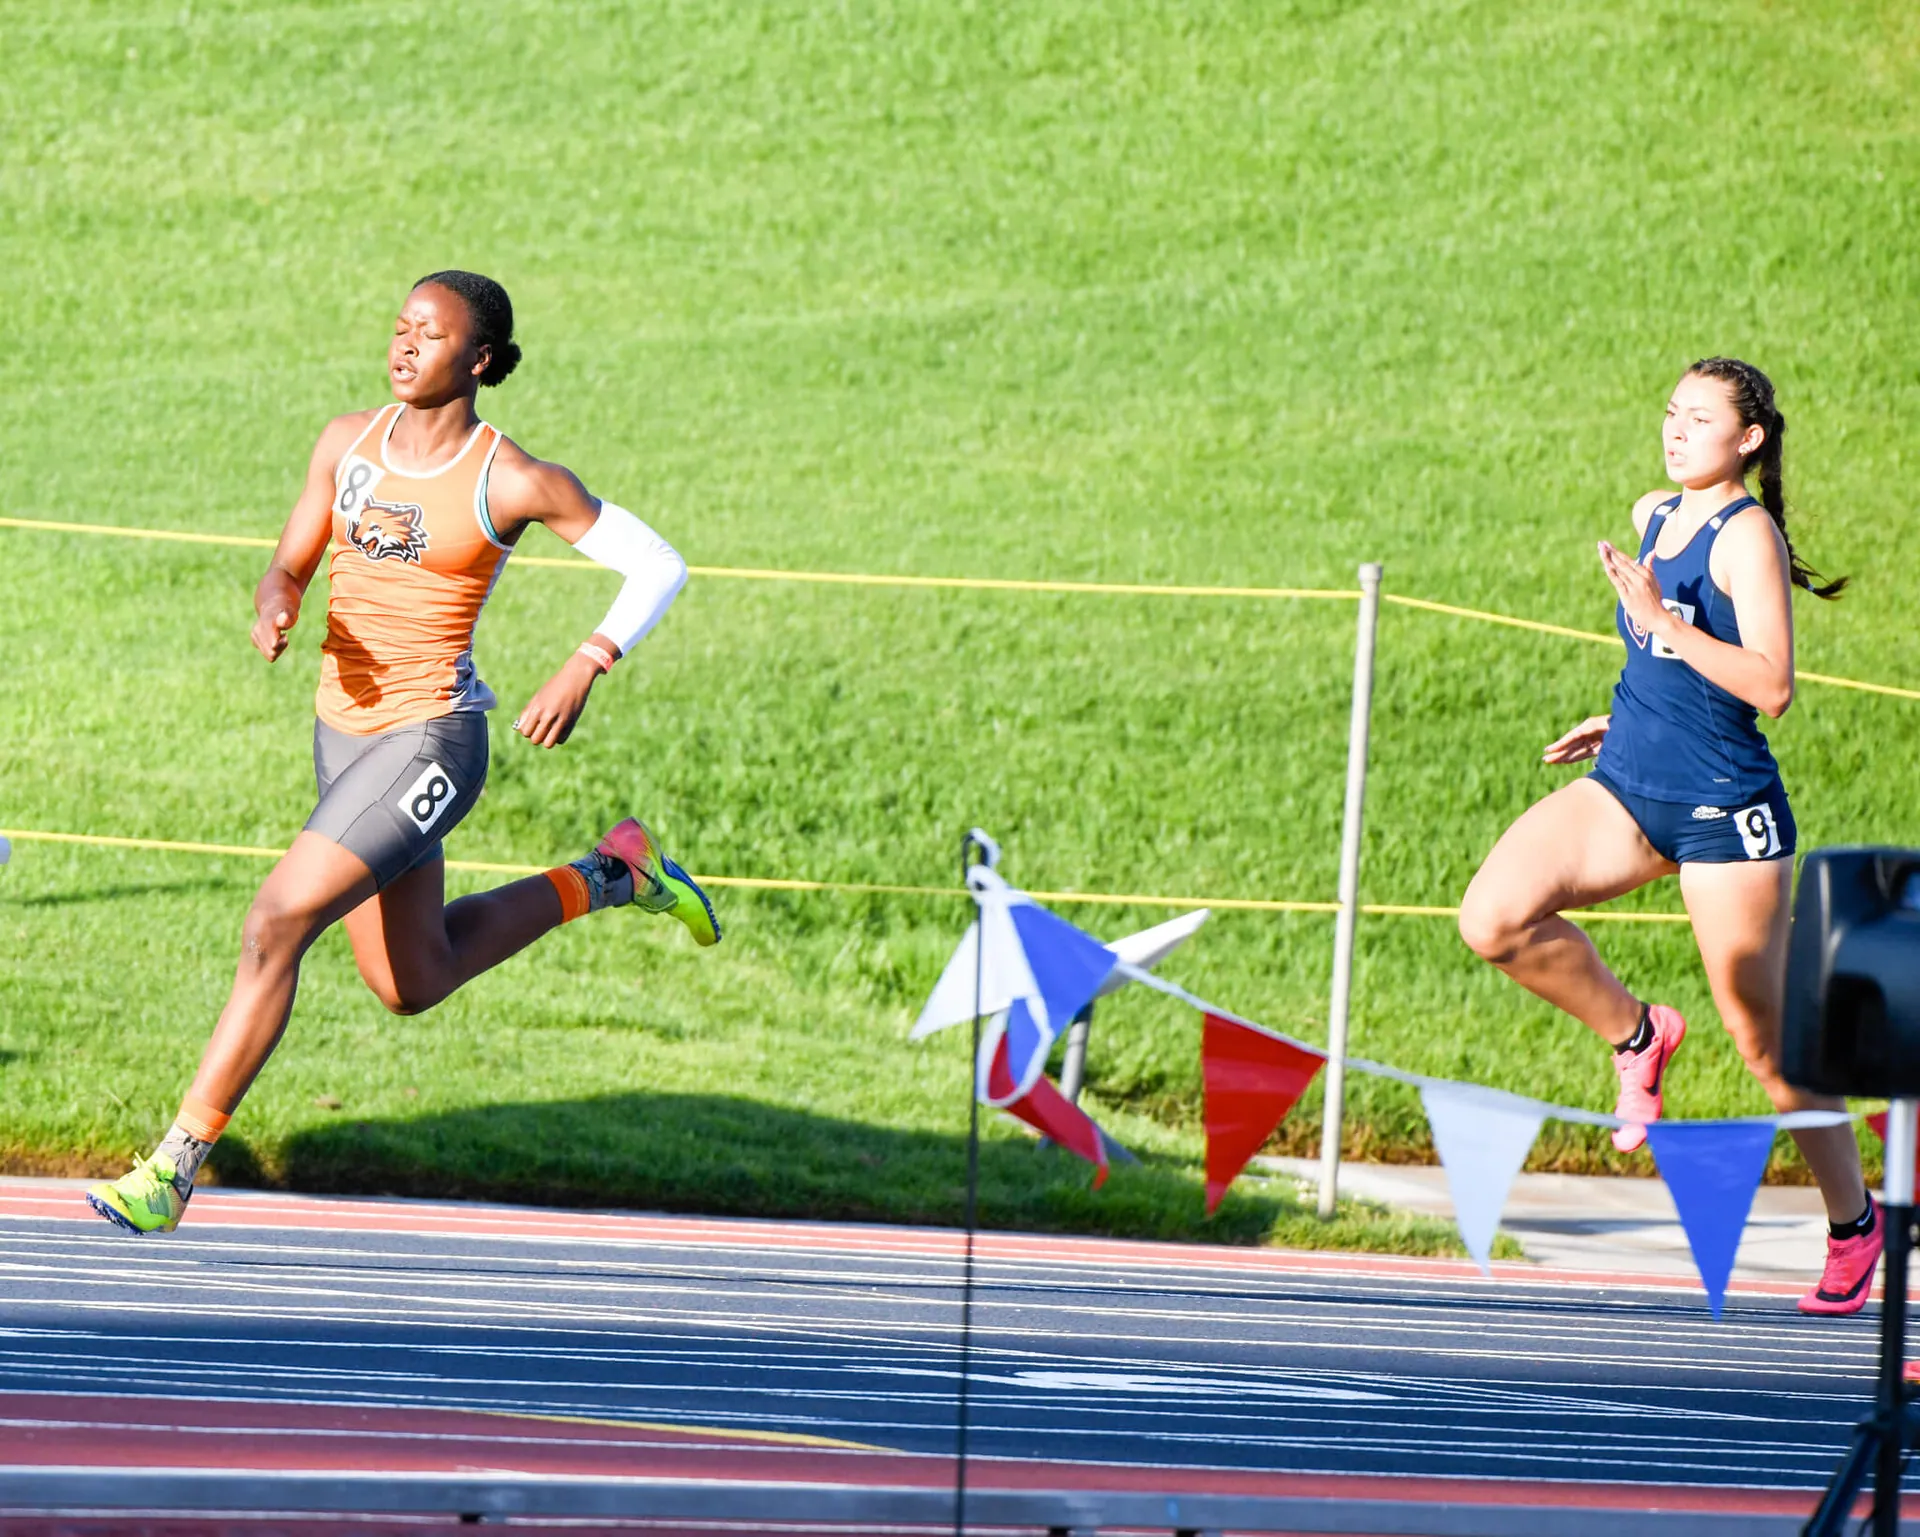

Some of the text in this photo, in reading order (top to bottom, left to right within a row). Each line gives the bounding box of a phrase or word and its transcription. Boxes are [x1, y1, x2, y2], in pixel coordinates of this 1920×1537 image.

[340, 463, 372, 512] 8
[411, 775, 449, 822] 8
[1746, 808, 1772, 857] 9
